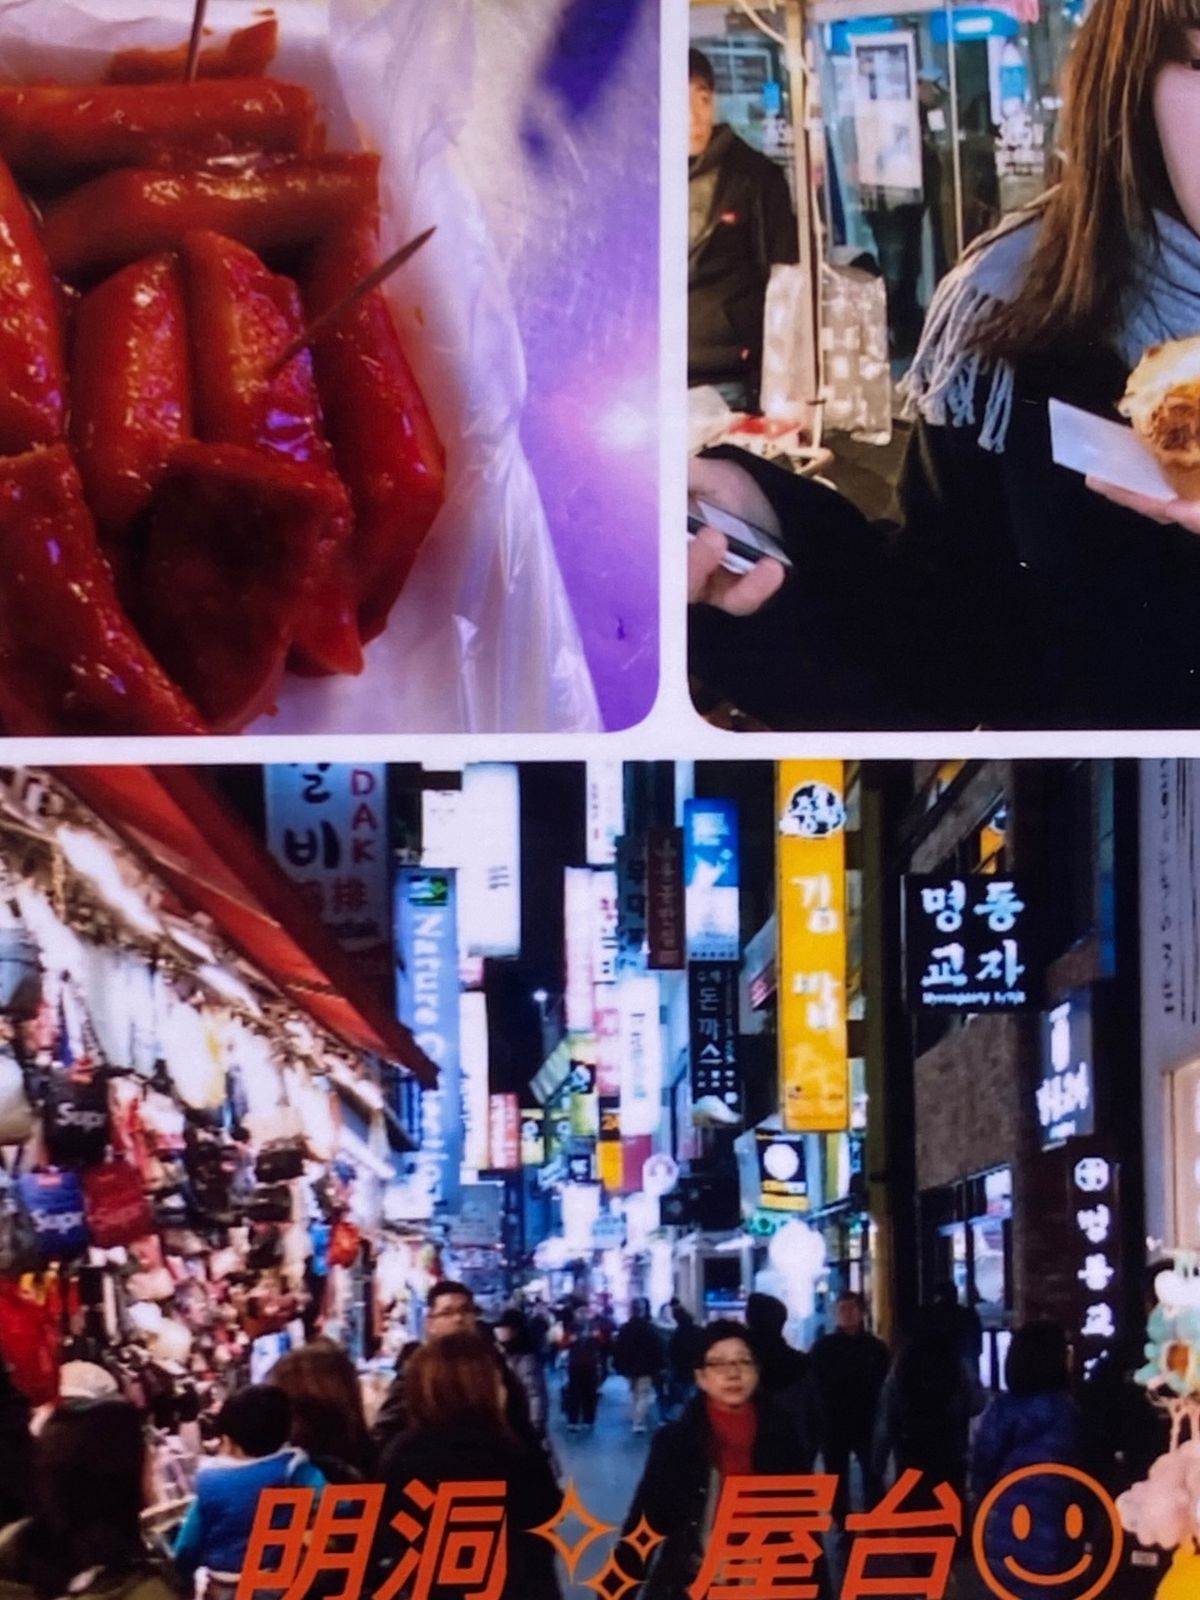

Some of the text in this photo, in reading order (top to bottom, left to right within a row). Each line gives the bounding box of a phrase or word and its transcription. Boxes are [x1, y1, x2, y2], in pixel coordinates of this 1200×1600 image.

[351, 769, 377, 865] DAK
[920, 880, 1025, 932] 명동
[789, 874, 842, 1030] 김밥
[920, 939, 1025, 988] 교자
